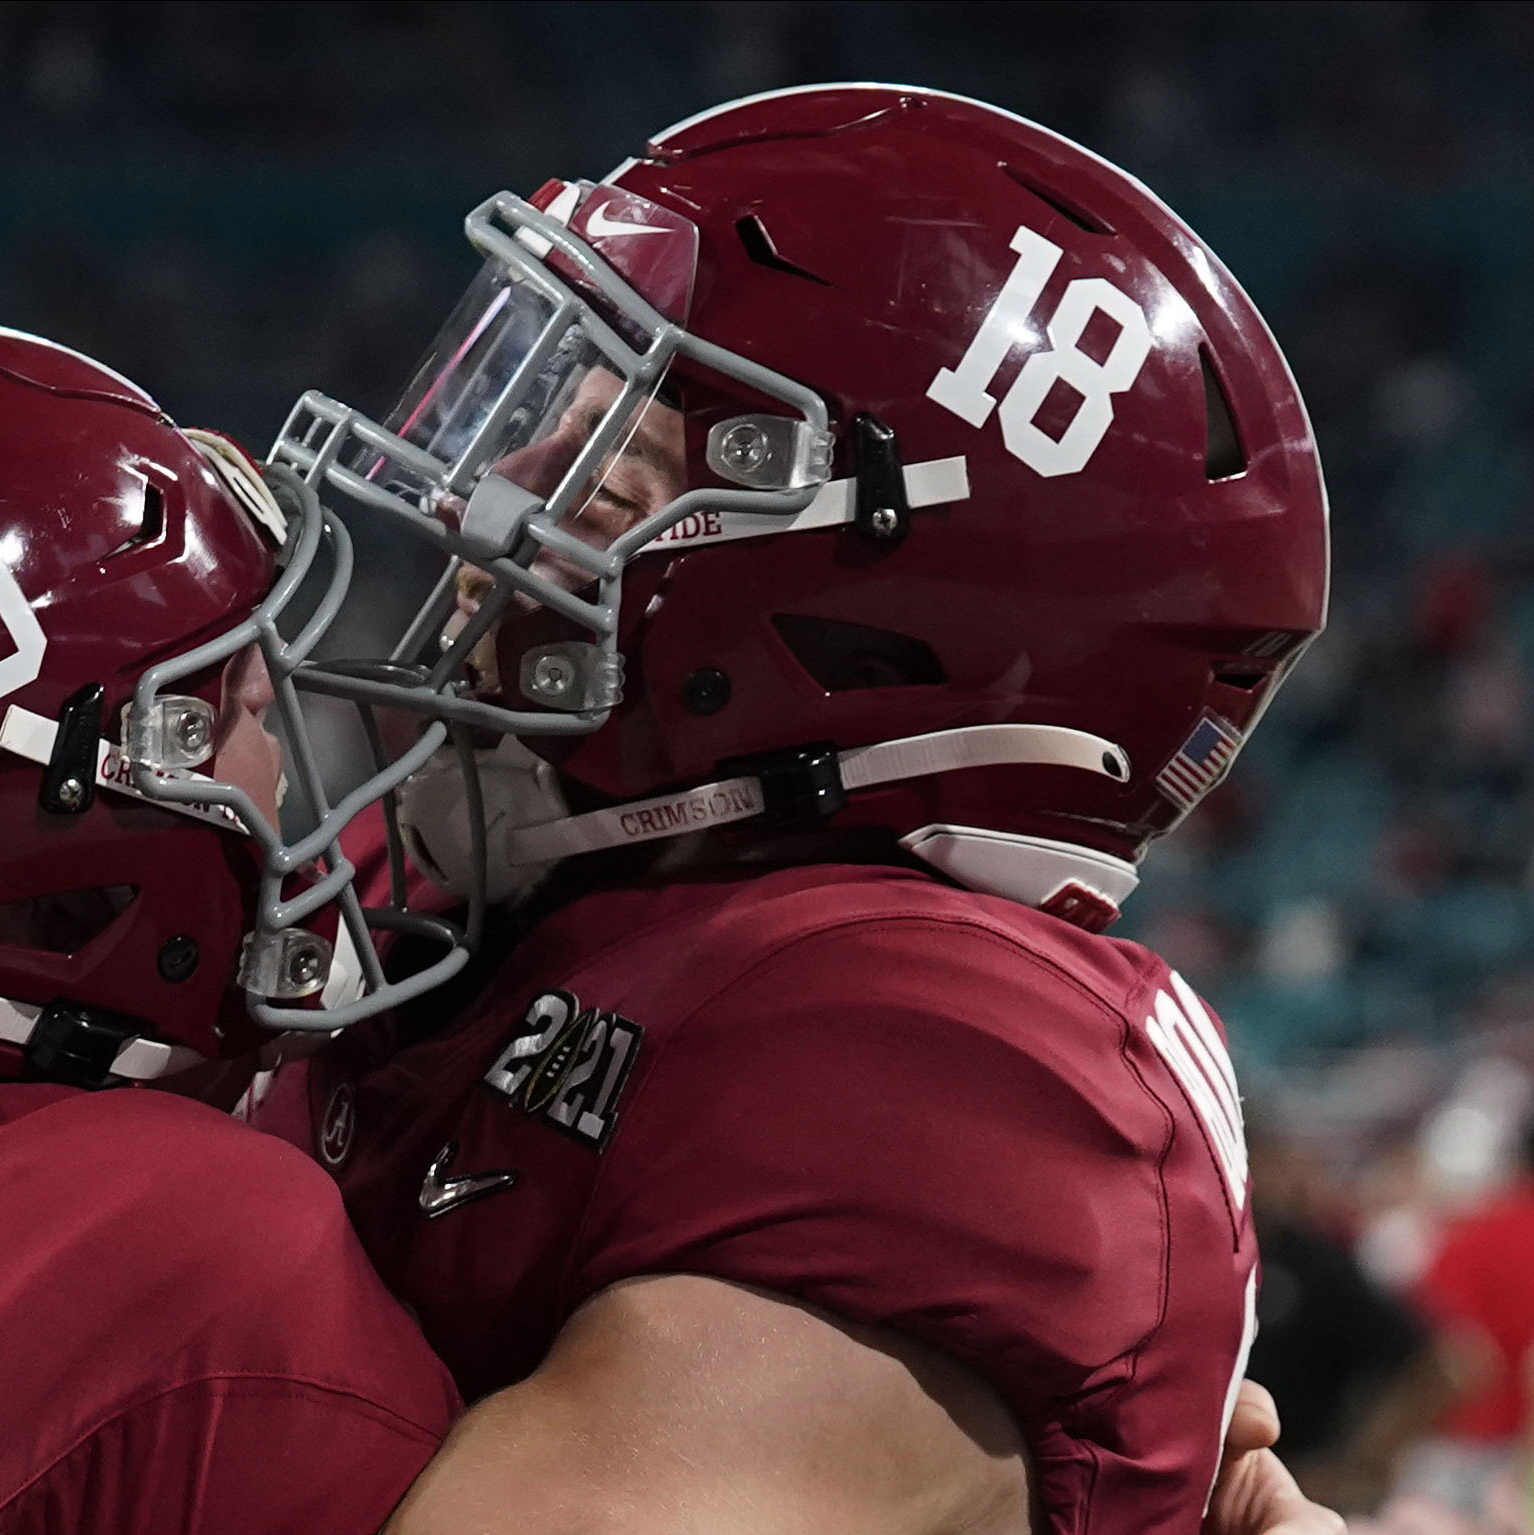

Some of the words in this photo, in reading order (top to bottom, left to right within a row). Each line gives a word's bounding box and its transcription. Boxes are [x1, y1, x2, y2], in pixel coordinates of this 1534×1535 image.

[926, 224, 1153, 478] 18
[655, 510, 722, 542] IDE
[620, 787, 755, 836] CRIMSON
